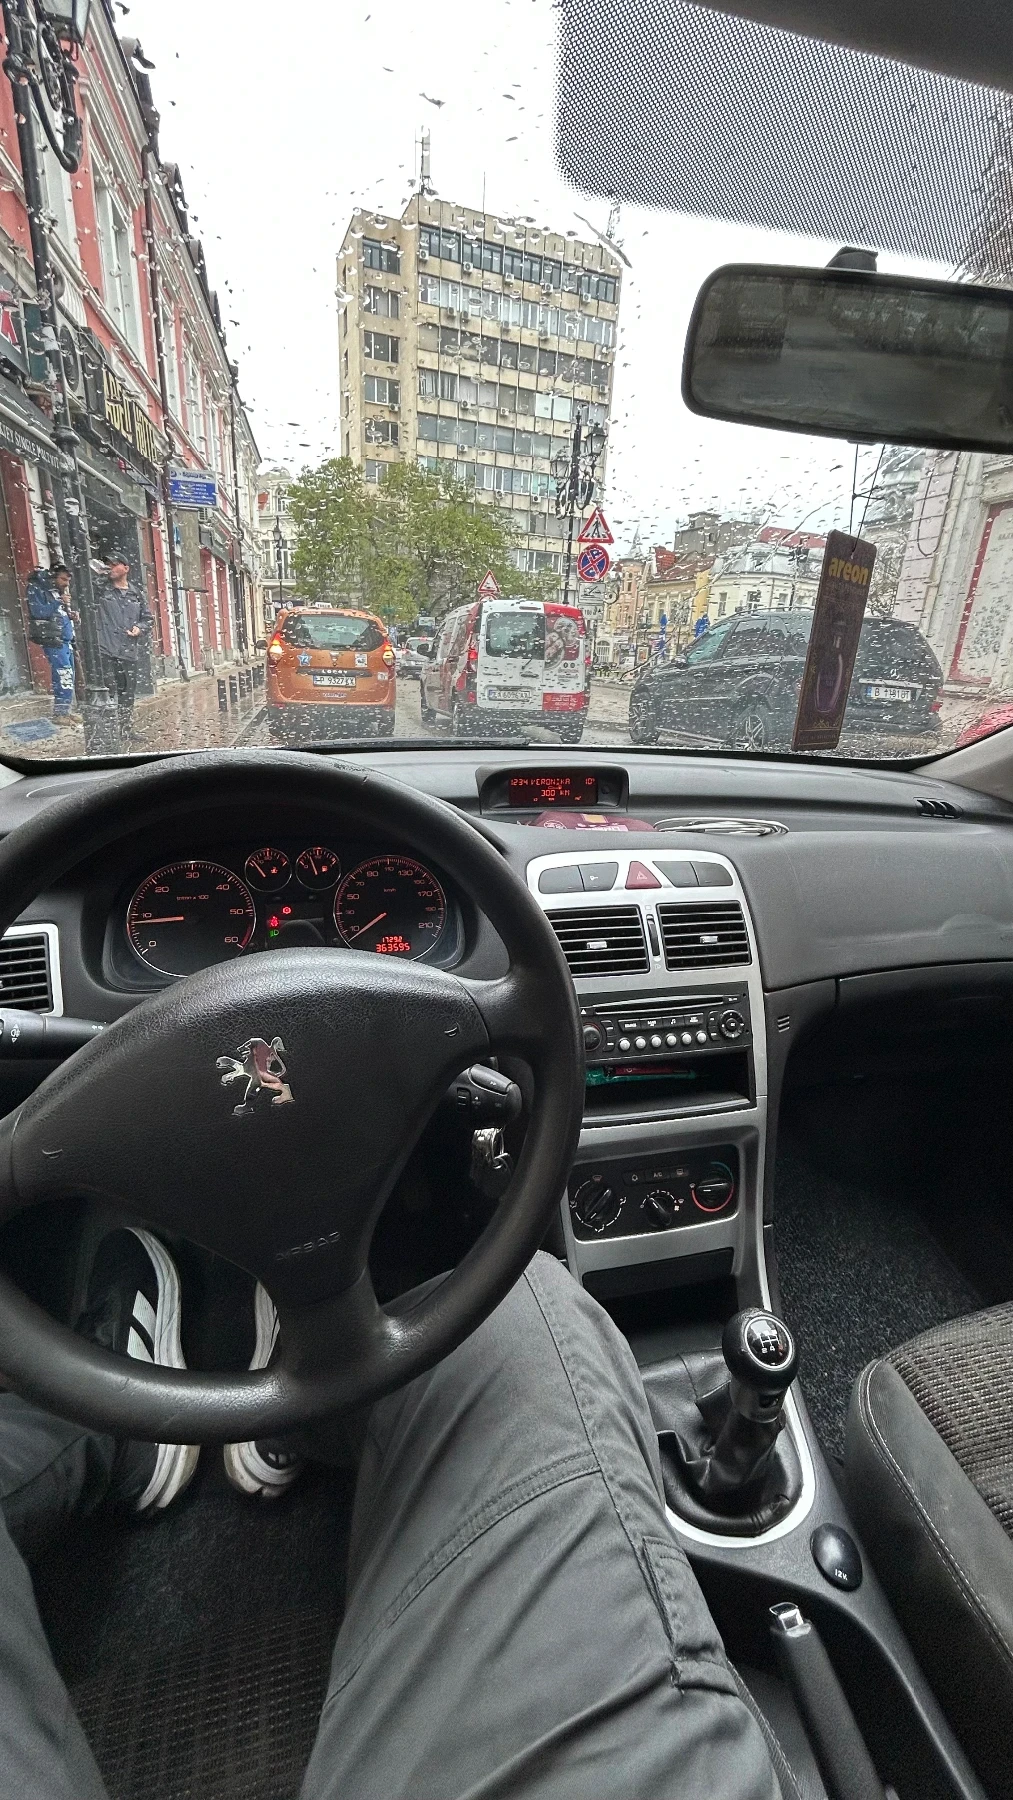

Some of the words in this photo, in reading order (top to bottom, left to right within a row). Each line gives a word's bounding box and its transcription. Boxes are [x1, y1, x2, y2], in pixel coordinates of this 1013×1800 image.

[828, 557, 868, 586] areon
[328, 677, 344, 685] 9327
[530, 778, 570, 786] VERONIKA
[376, 942, 410, 952] 363595
